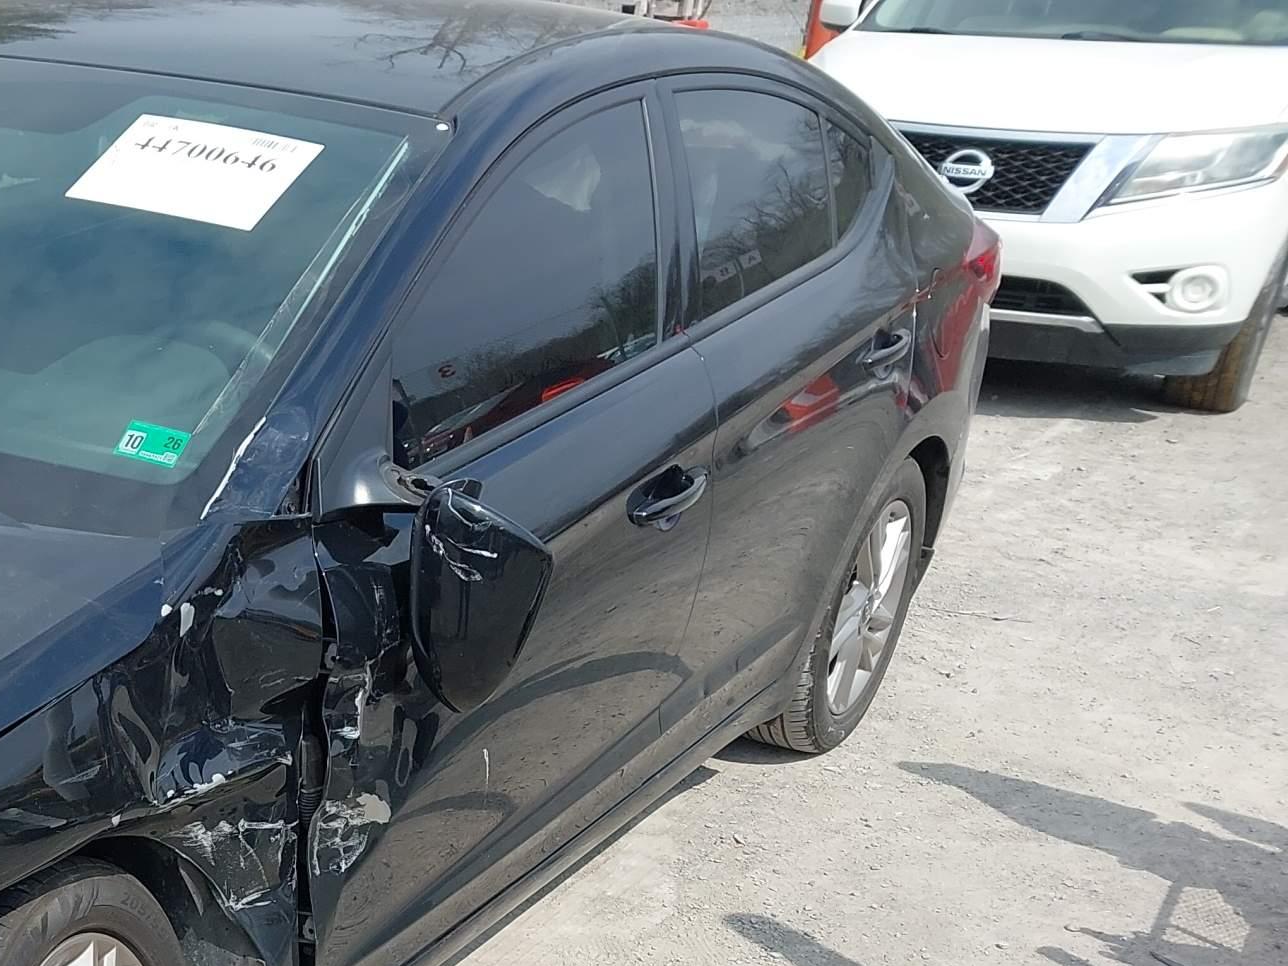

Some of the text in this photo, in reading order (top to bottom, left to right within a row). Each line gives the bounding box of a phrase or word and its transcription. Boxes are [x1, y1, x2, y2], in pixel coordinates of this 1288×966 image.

[135, 136, 277, 173] 44700646
[943, 166, 987, 176] NISSAN
[124, 433, 183, 451] 10 26
